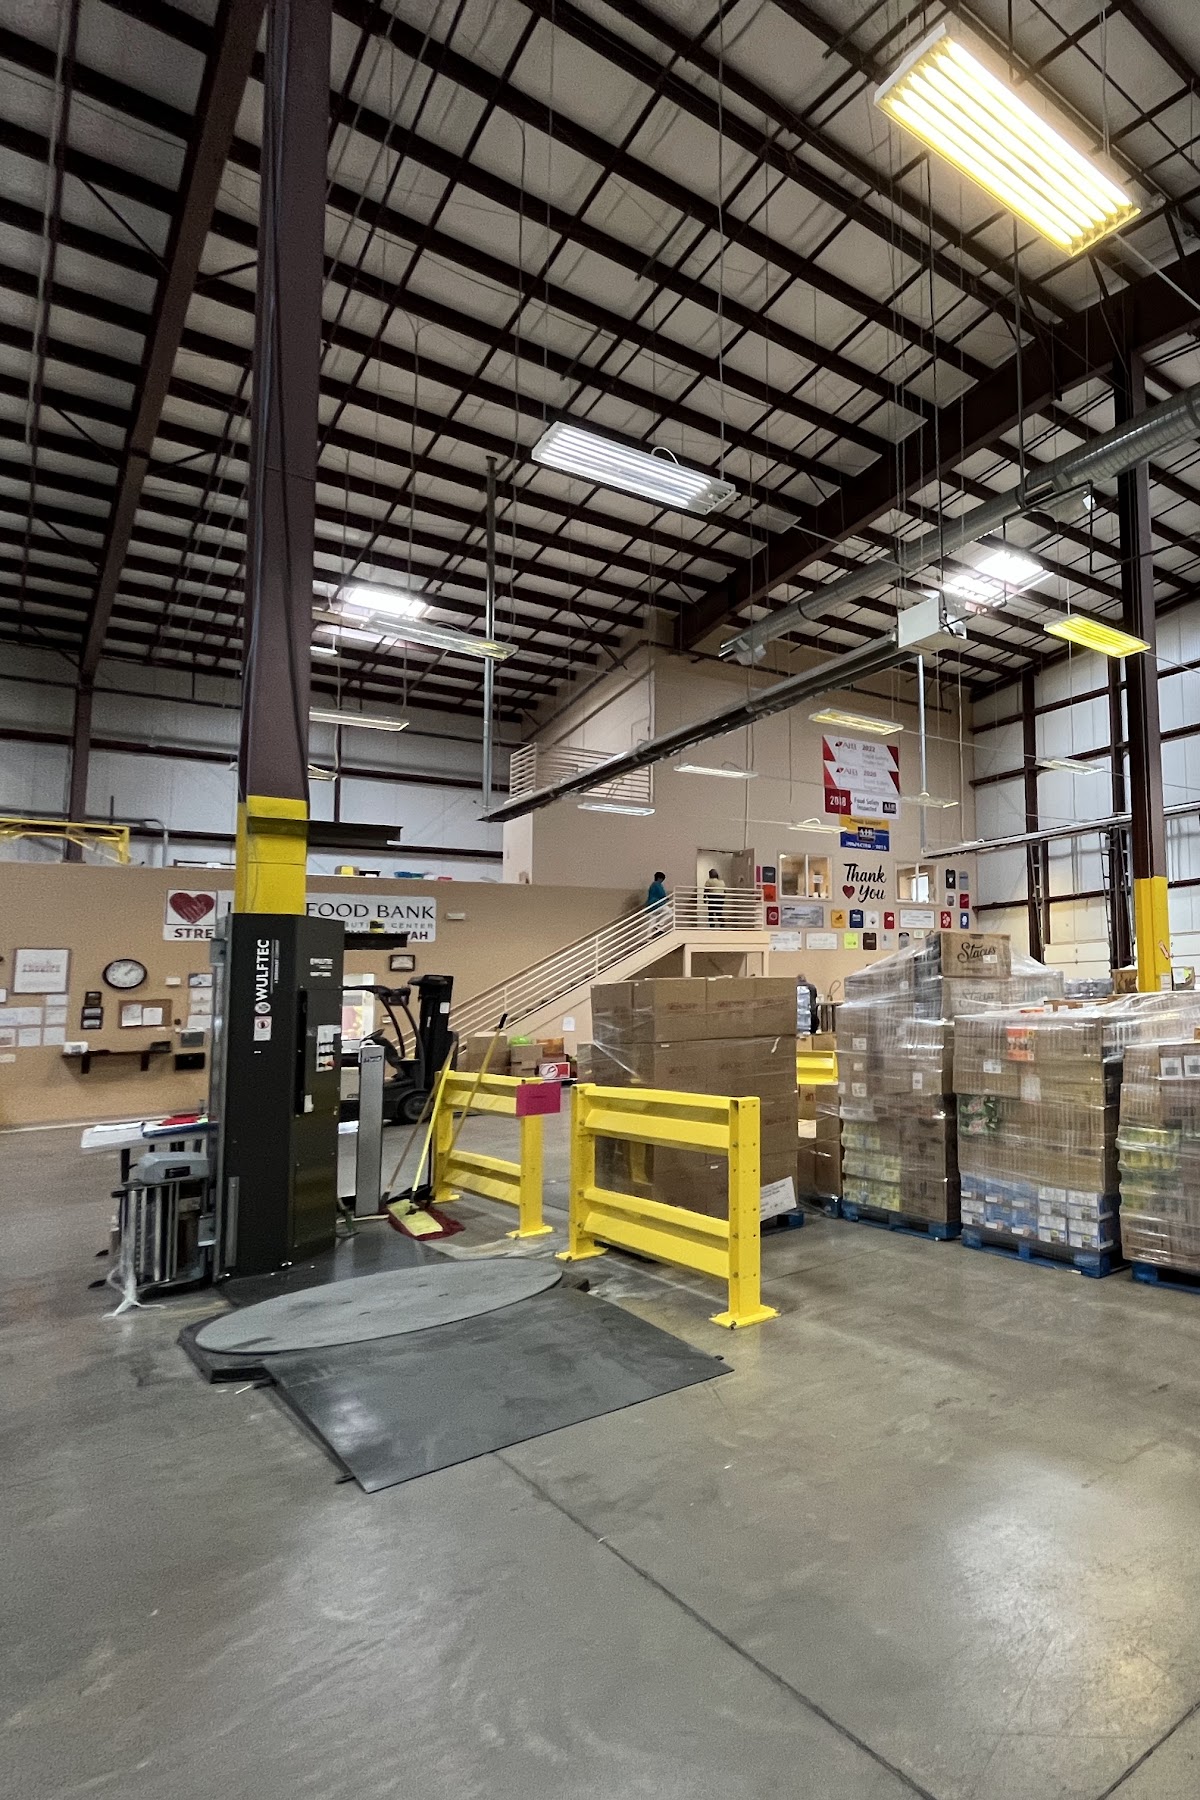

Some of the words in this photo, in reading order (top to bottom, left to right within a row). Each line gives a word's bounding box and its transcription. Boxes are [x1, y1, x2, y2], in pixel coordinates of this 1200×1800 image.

[843, 863, 887, 883] Thank
[858, 884, 886, 903] You
[306, 902, 370, 918] FOOD
[377, 904, 435, 919] BANK
[174, 928, 214, 939] STRE
[255, 939, 270, 1002] WULFTEC
